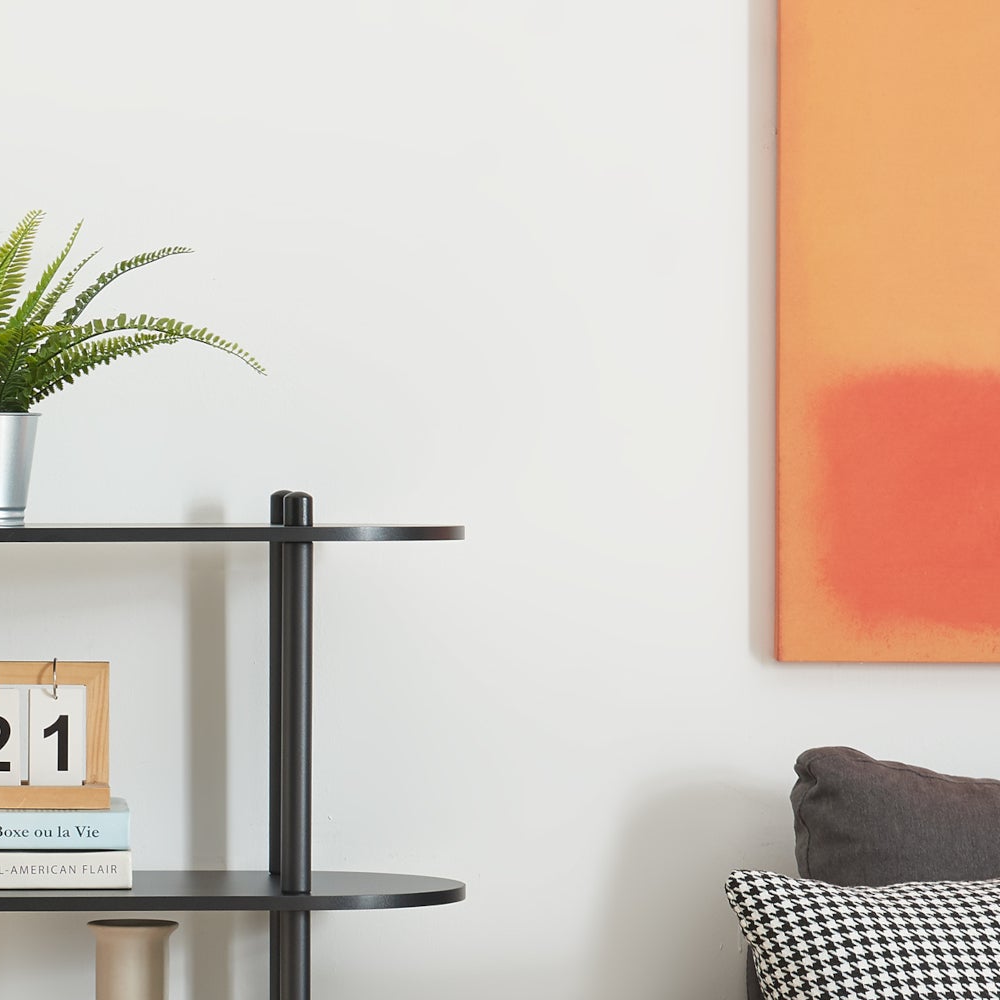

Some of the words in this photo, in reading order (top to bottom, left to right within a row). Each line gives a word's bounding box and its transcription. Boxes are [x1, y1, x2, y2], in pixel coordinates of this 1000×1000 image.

[43, 714, 69, 772] 1
[34, 828, 53, 838] ou
[57, 825, 71, 838] la
[75, 825, 100, 838] Vie
[82, 864, 118, 874] FLAIR
